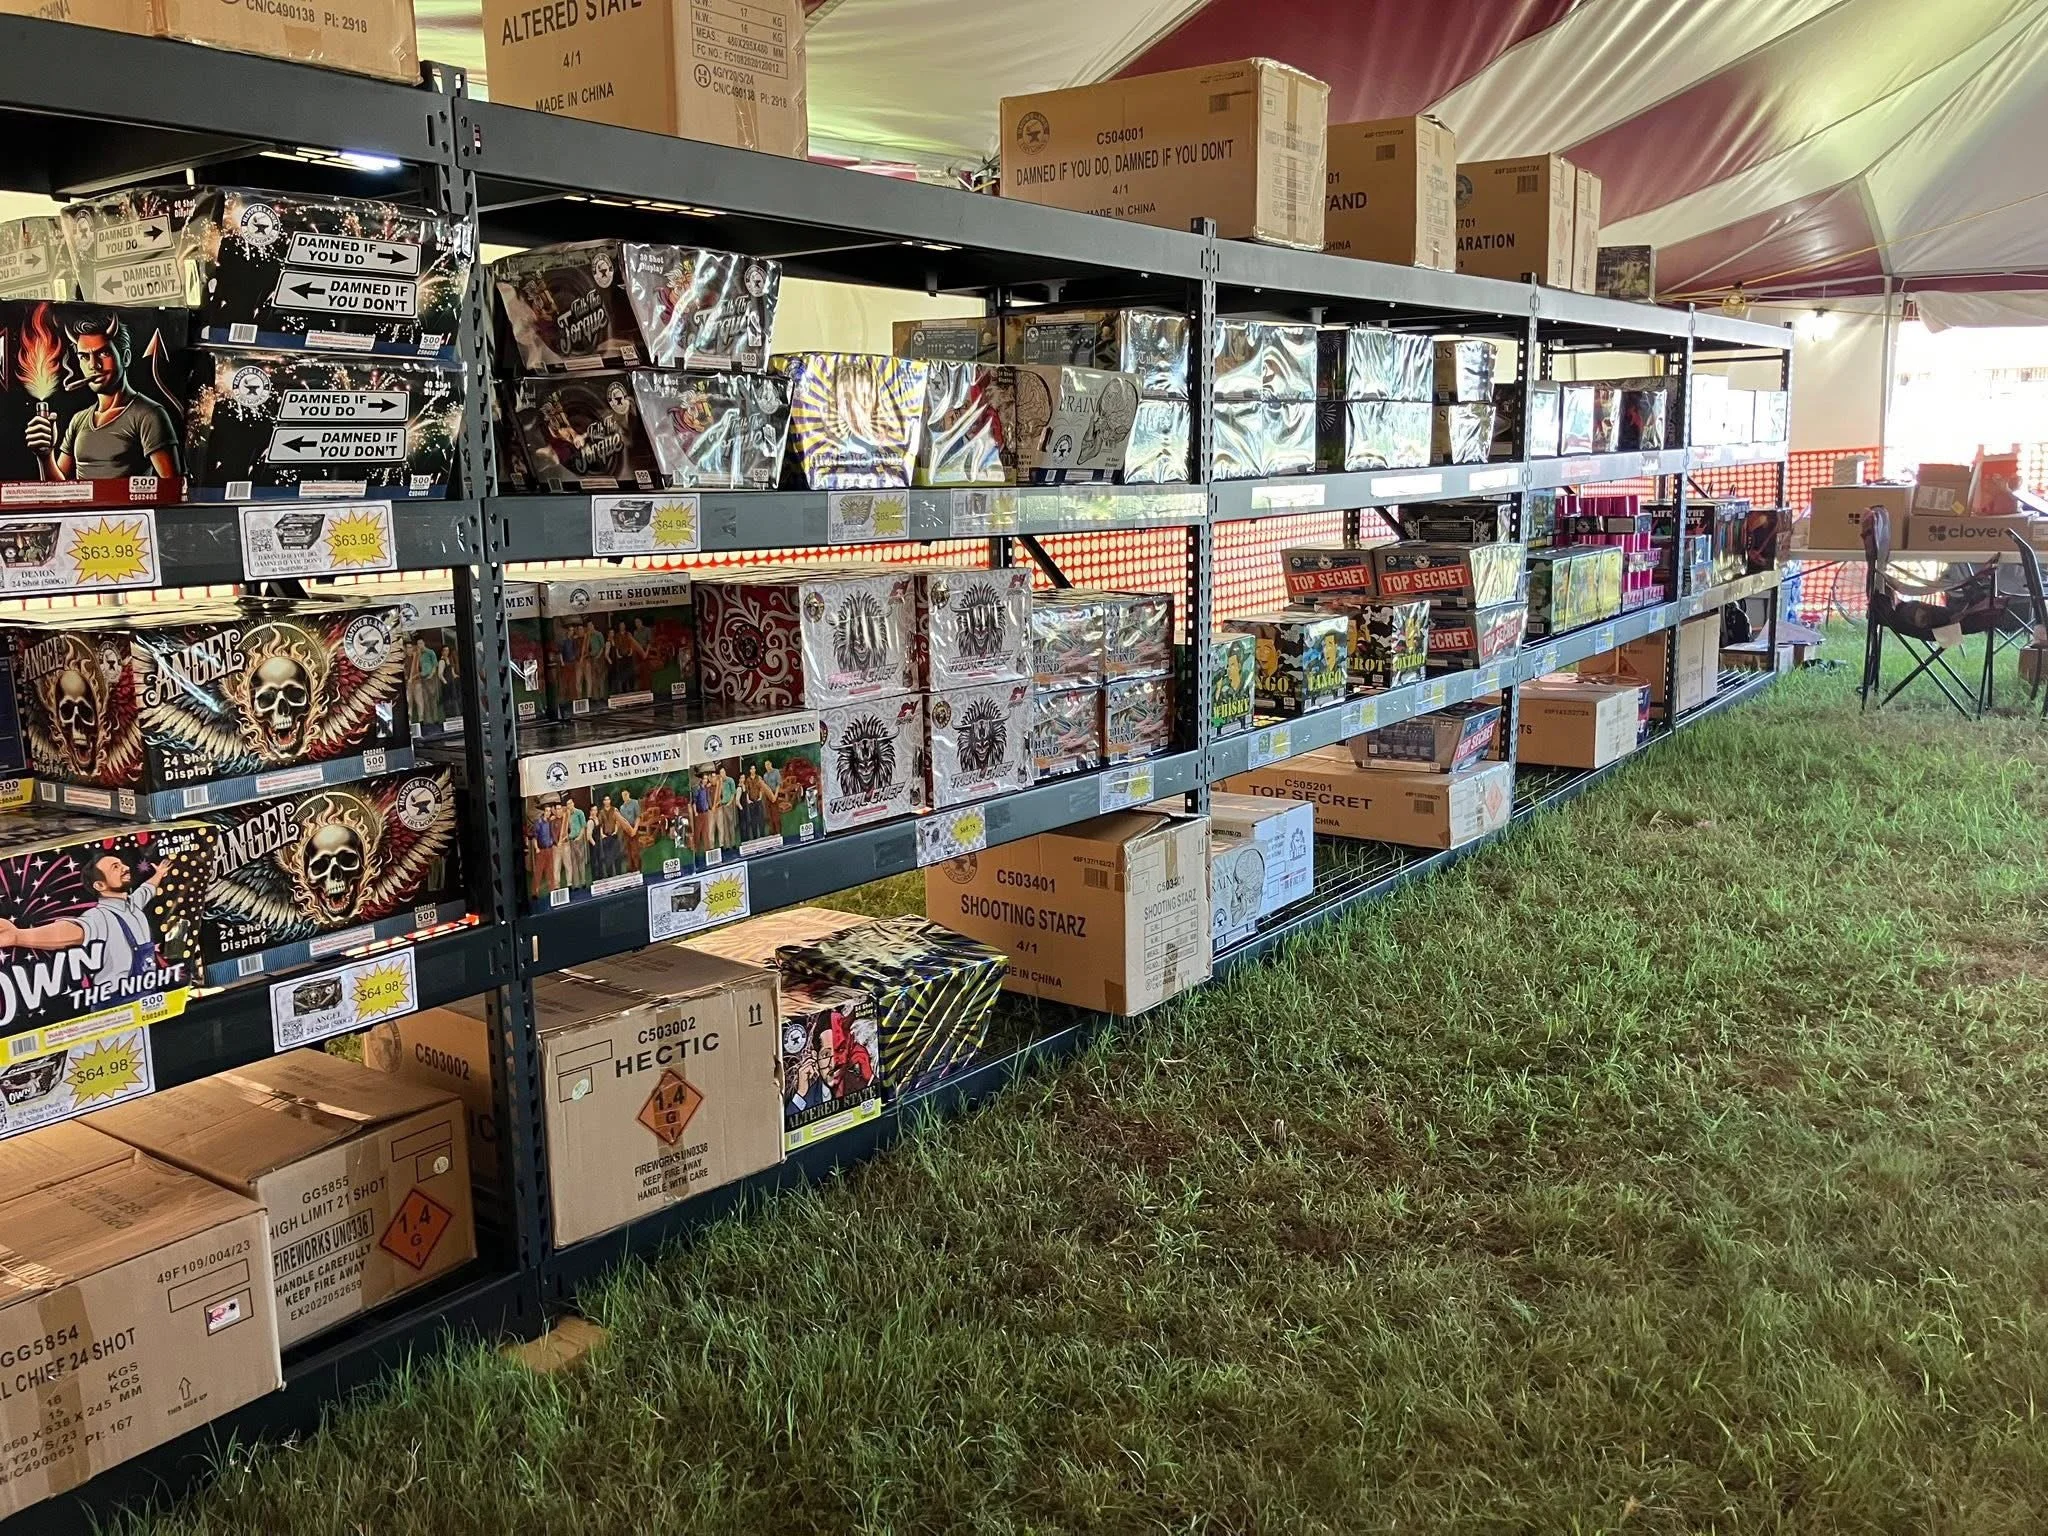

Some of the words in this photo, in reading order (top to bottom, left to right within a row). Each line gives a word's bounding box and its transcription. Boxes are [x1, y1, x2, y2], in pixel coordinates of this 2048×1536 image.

[247, 0, 315, 23] CN/C490138
[324, 13, 339, 28] PI:
[342, 17, 367, 33] 2918
[501, 1, 578, 45] ALTERED
[772, 17, 782, 27] KG
[772, 32, 782, 42] KG
[563, 51, 581, 68] 4/1
[536, 94, 564, 112] MADE
[568, 90, 577, 107] IN
[581, 83, 614, 103] CHINA
[1096, 127, 1144, 145] C504001
[1016, 165, 1056, 186] DAMNED
[1059, 163, 1068, 180] IF
[1070, 159, 1091, 178] YOU
[1093, 158, 1112, 178] DO,
[1115, 151, 1159, 174] DAMNED
[1162, 149, 1171, 167] IF
[1174, 145, 1197, 165] YOU
[1201, 139, 1234, 161] DON'T
[1112, 184, 1129, 195] 4/1
[1115, 206, 1124, 216] IN
[1127, 202, 1156, 215] CHINA
[99, 226, 133, 243] DAMNED
[135, 223, 142, 233] IF
[105, 242, 123, 254] YOU
[125, 240, 138, 250] DO
[298, 236, 360, 252] DAMNED
[364, 243, 377, 253] IF
[309, 251, 339, 263] YOU
[344, 254, 365, 265] DO
[123, 266, 162, 282] DAMNED
[164, 263, 172, 275] IF
[124, 283, 144, 299] YOU
[146, 279, 176, 296] DON'T
[330, 281, 390, 295] DAMNED
[395, 286, 408, 296] IF
[327, 294, 358, 308] YOU
[363, 298, 407, 312] DON'T
[423, 336, 440, 344] 500
[557, 307, 608, 354] Torque
[435, 381, 450, 389] Shot
[289, 394, 351, 404] DAMNED
[355, 395, 367, 404] IF
[300, 407, 331, 416] YOU
[336, 407, 355, 416] DO
[321, 432, 382, 443] DAMNED
[386, 432, 398, 442] IF
[320, 446, 351, 458] YOU
[354, 446, 397, 457] DON'T
[575, 432, 624, 473] Torque
[132, 477, 155, 486] 500
[413, 476, 429, 484] 500
[334, 533, 376, 546] $63.98
[1949, 525, 2003, 538] clover
[81, 545, 134, 560] $63.98
[21, 570, 56, 579] DEMON
[23, 579, 39, 587] Shot
[1292, 575, 1316, 592] TOP
[1318, 569, 1365, 587] SECRET
[1384, 574, 1415, 592] TOP
[1417, 568, 1464, 587] SECRET
[598, 589, 623, 600] THE
[628, 585, 687, 599] SHOWMEN
[1429, 631, 1469, 648] ECRET
[145, 629, 245, 706] ANGEL
[1106, 652, 1135, 664] STAND
[730, 733, 754, 745] THE
[759, 722, 815, 740] SHOWMEN
[1108, 733, 1136, 744] STAND
[163, 756, 179, 766] 24
[184, 752, 212, 764] Shot
[366, 756, 384, 767] 500
[578, 760, 608, 774] THE
[612, 748, 680, 769] SHOWMEN
[165, 762, 214, 781] Display
[634, 766, 660, 775] Display
[867, 782, 905, 804] CHIEF
[1284, 779, 1333, 792] C505201
[1249, 785, 1286, 798] TOP
[1292, 790, 1373, 810] SECRET
[1315, 817, 1340, 827] CHINA
[158, 838, 169, 847] 24
[172, 833, 195, 845] Shot
[159, 843, 197, 856] Display
[208, 802, 299, 883] ANGEL
[664, 861, 679, 869] 500
[997, 869, 1056, 893] C503401
[1144, 896, 1177, 920] SHOOTING
[1178, 888, 1197, 906] STARZ
[417, 910, 436, 921] 500
[961, 894, 1035, 927] SHOOTING
[1039, 910, 1086, 938] STARZ
[220, 930, 234, 940] 24
[238, 922, 267, 936] Shot
[221, 933, 268, 952] Display
[1016, 940, 1038, 954] 4/1
[69, 983, 119, 1010] THE
[119, 962, 185, 997] NIGHT
[1019, 969, 1029, 979] IN
[1031, 971, 1062, 988] CHINA
[359, 981, 399, 1001] $64.98
[141, 995, 163, 1007] 500
[315, 1012, 343, 1024] ANGEL
[638, 1017, 697, 1044] C503002
[415, 1042, 470, 1080] C503002
[615, 1032, 720, 1078] HECTIC
[77, 1059, 129, 1084] $64.98
[9, 1087, 31, 1103] OWN
[655, 1087, 685, 1111] 1.4
[788, 1100, 840, 1128] ALTERED
[843, 1086, 876, 1105] STATE
[666, 1112, 676, 1123] G
[634, 1152, 680, 1177] FIREWORKS
[680, 1143, 708, 1160] UN0336
[642, 1173, 662, 1187] KEEP
[664, 1166, 680, 1180] FIRE
[683, 1159, 702, 1173] AWAY
[302, 1175, 350, 1204] GG5855
[638, 1183, 668, 1201] HANDLE
[669, 1176, 688, 1189] WITH
[689, 1168, 708, 1181] CARE
[269, 1215, 298, 1241] HIGH
[301, 1200, 334, 1225] LIMIT
[337, 1194, 350, 1210] 21
[353, 1177, 386, 1201] SHOT
[400, 1204, 431, 1234] 1.4
[273, 1233, 331, 1276] FIREWORKS
[333, 1214, 369, 1245] UN0336
[410, 1233, 422, 1246] G
[156, 1240, 251, 1285] 49F109/004/23
[276, 1269, 314, 1297] HANDLE
[318, 1243, 372, 1276] CAREFULLY
[285, 1287, 311, 1307] KEEP
[314, 1276, 335, 1296] FIRE
[339, 1260, 366, 1283] AWAY
[290, 1280, 363, 1321] EX2022052659
[0, 1324, 79, 1368] GG5854
[15, 1358, 66, 1392] CHIEF
[70, 1349, 89, 1371] 24
[92, 1327, 136, 1361] SHOT
[107, 1362, 138, 1381] KGS
[109, 1374, 141, 1393] KGS
[33, 1430, 41, 1441] X
[74, 1411, 83, 1423] X
[87, 1400, 112, 1416] 245
[119, 1386, 143, 1403] MM
[84, 1431, 105, 1446] PI:
[110, 1416, 133, 1433] 167
